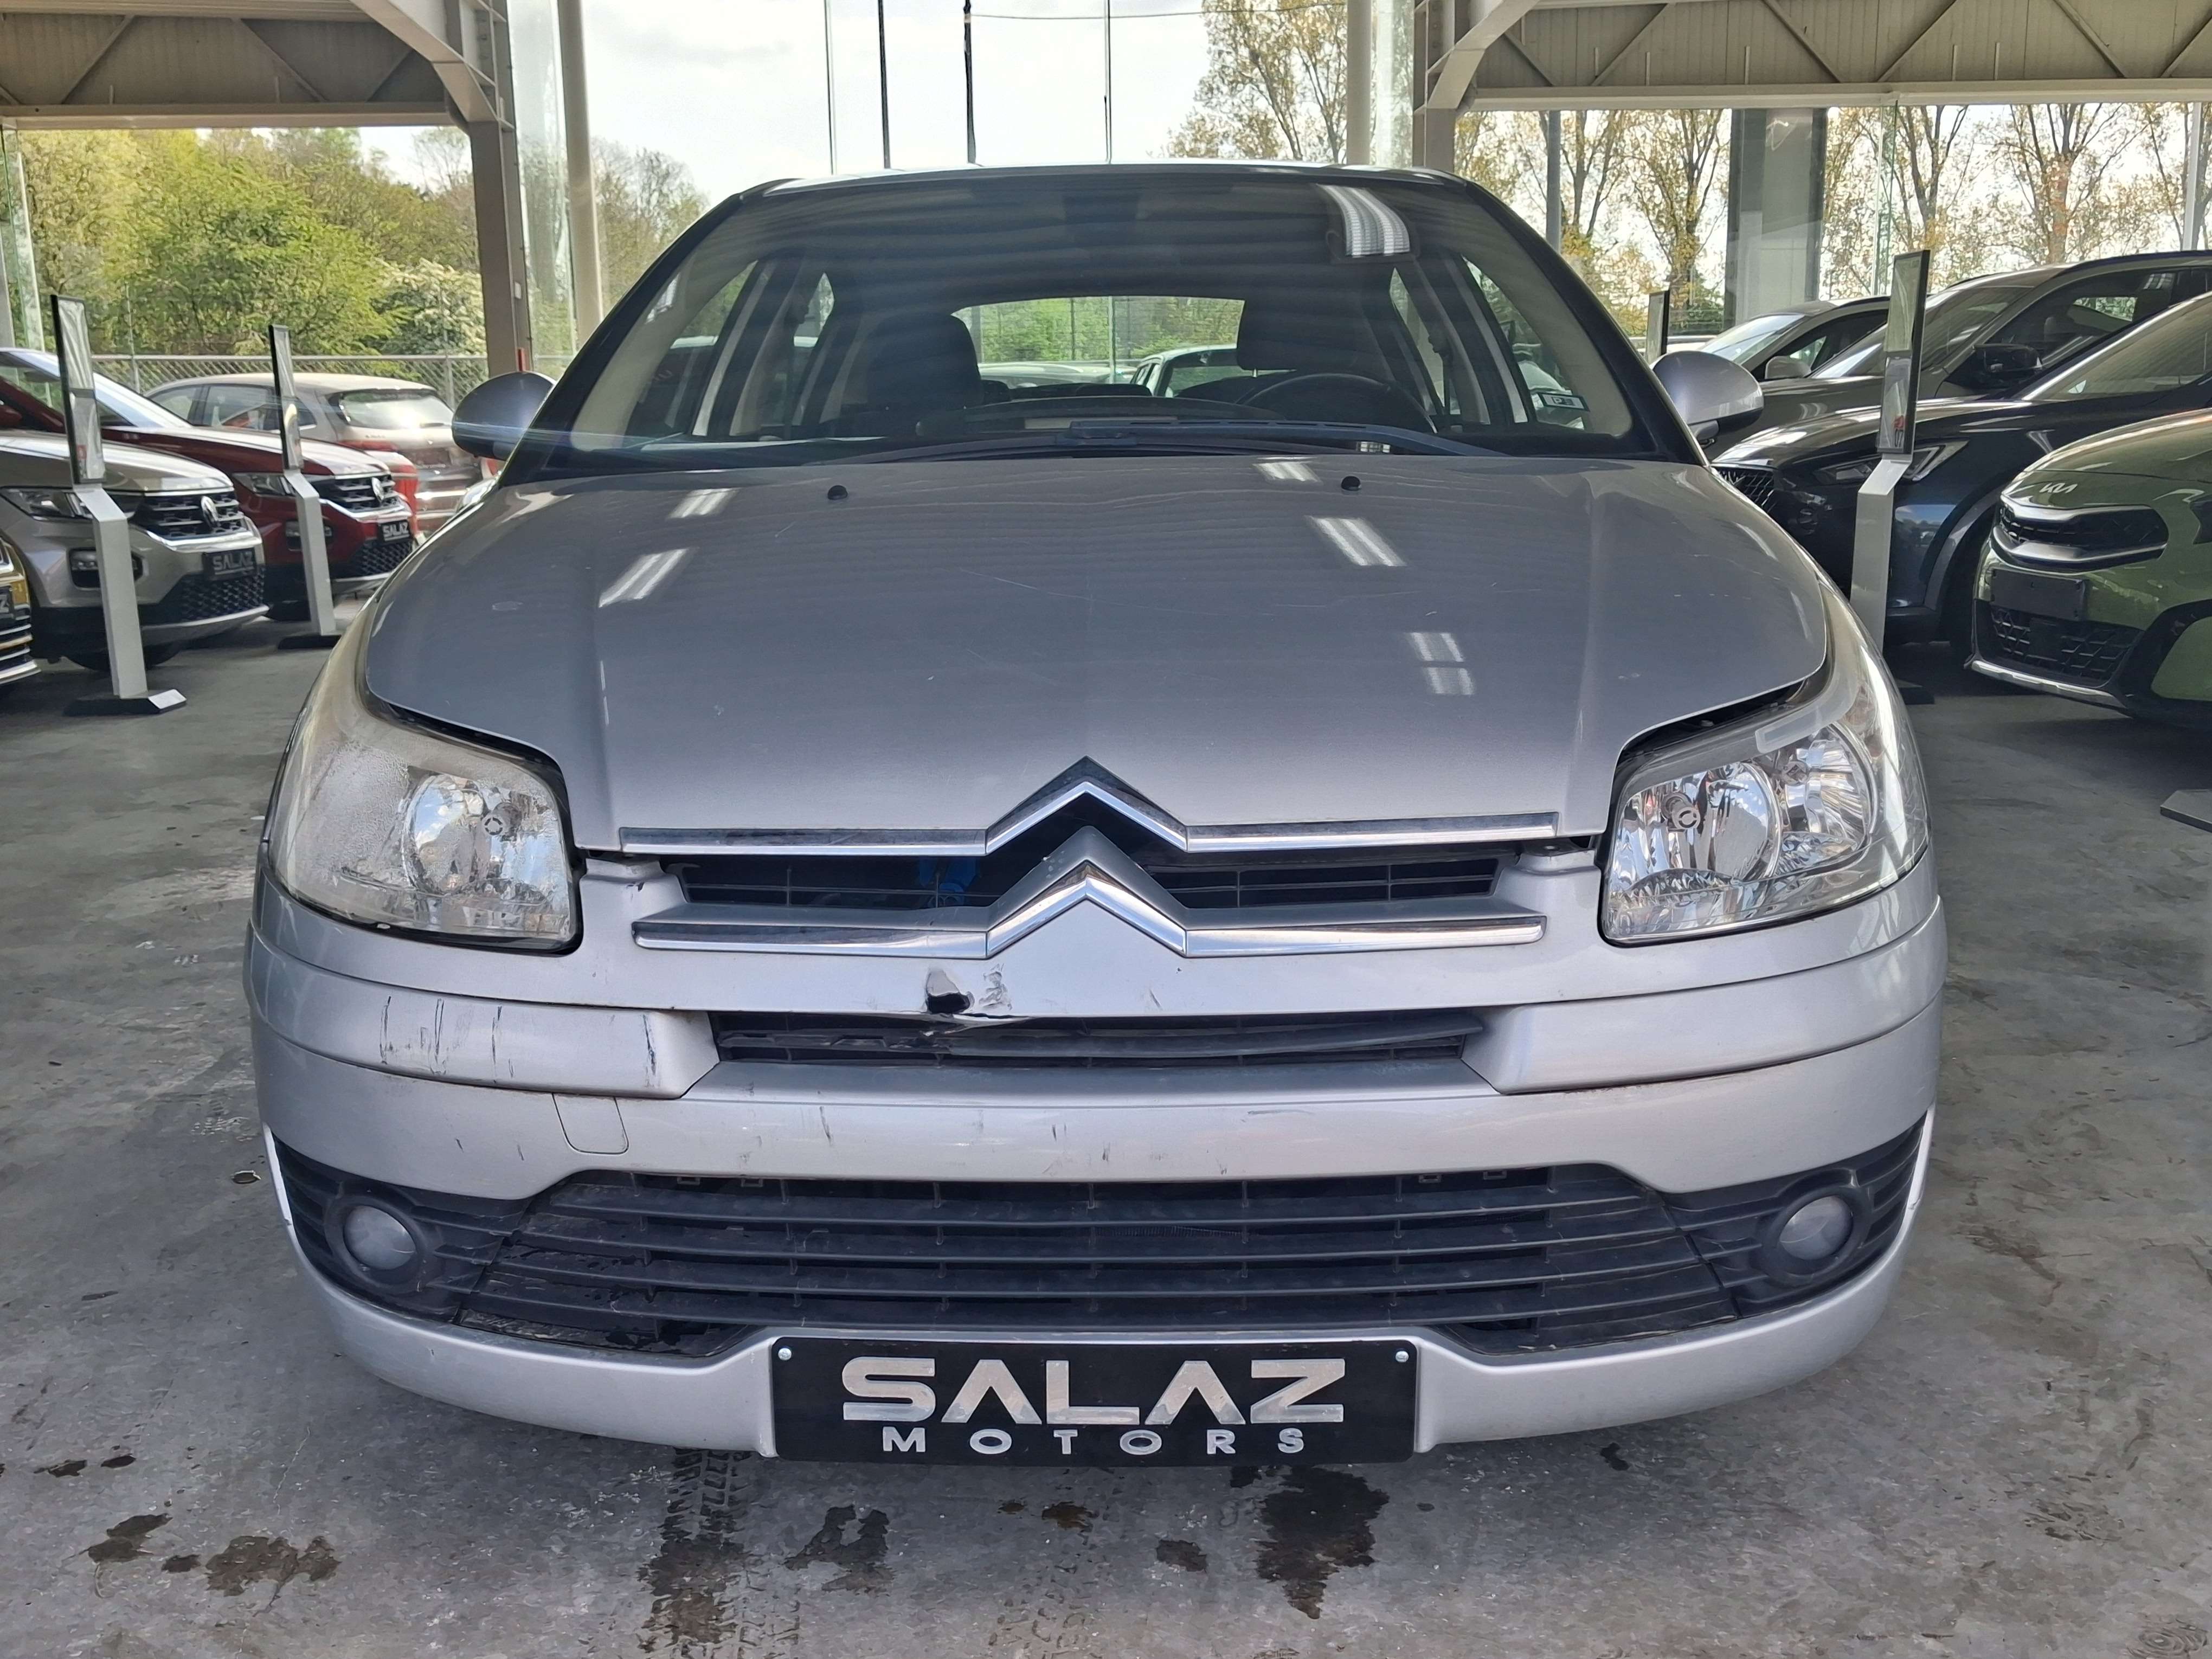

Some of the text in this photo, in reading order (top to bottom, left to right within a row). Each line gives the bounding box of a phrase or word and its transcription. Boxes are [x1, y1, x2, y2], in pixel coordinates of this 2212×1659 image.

[383, 522, 409, 538] SALAZ
[213, 551, 254, 571] SALAZ
[842, 1356, 1346, 1425] SALAZ
[883, 1426, 1304, 1456] MOTORS
